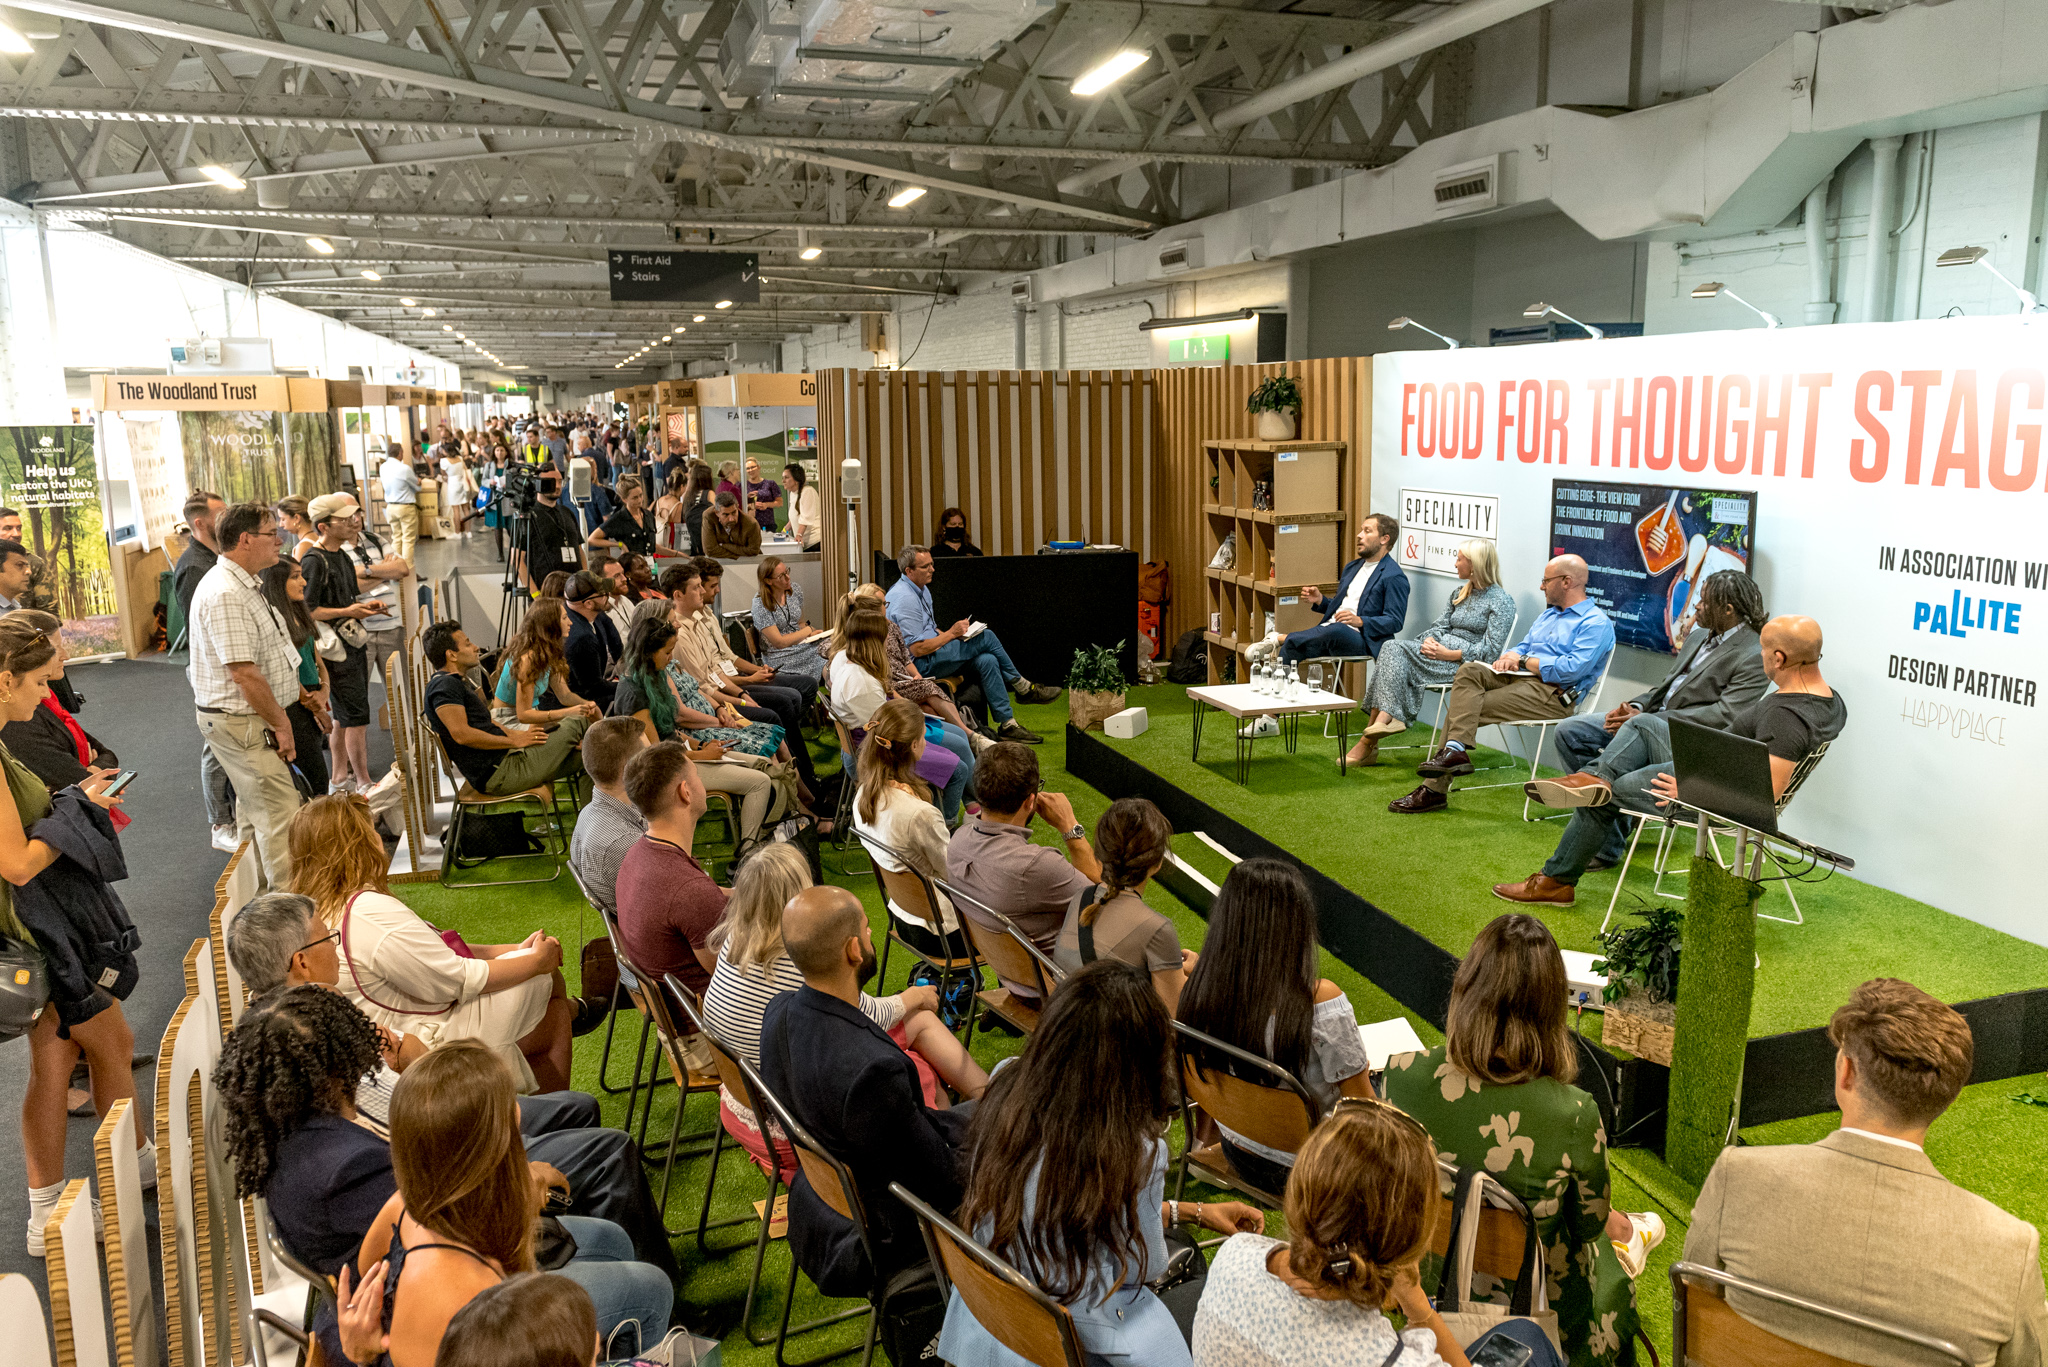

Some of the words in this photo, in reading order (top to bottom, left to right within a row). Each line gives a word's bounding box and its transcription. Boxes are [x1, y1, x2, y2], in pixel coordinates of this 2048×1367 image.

[631, 255, 653, 265] First
[655, 256, 671, 265] Aid
[631, 271, 660, 281] Stairs
[117, 382, 144, 400] The
[148, 382, 218, 400] Woodland
[221, 382, 257, 400] Trust
[727, 411, 760, 420] FARE
[1401, 382, 1485, 460] FOOD
[1496, 379, 1570, 464] FOR
[1587, 373, 1833, 479] THOUGHT
[1849, 368, 2048, 493] STAG
[210, 432, 304, 446] WOODLAD
[243, 448, 274, 457] TRUST
[25, 464, 57, 480] Help
[60, 466, 76, 476] us
[10, 480, 48, 490] restore
[50, 479, 67, 489] the
[69, 478, 93, 488] UK's
[11, 491, 50, 502] natural
[52, 490, 95, 501] habitats
[1556, 487, 1580, 501] CUTTING
[1596, 490, 1607, 504] THE
[1608, 491, 1623, 505] VIEW
[1623, 493, 1641, 507] FROM
[1714, 500, 1747, 511] SPECIALITY
[1406, 497, 1492, 532] SPECIALITY
[1556, 505, 1566, 518] THE
[1566, 506, 1595, 521] FRONTLINE
[1595, 508, 1603, 522] OF
[1603, 509, 1619, 524] FOOD
[1618, 511, 1632, 525] AND
[1554, 523, 1572, 536] DRINK
[1571, 524, 1605, 540] INNOVATION
[1406, 535, 1419, 560] &
[1427, 545, 1444, 556] FINE
[1879, 546, 1896, 571] IN
[1900, 548, 2018, 587] ASSOCIATION
[1888, 654, 1949, 690] DESIGN
[1953, 666, 2037, 708] PARTNER
[1900, 696, 2007, 746] HAPPYPLACE
